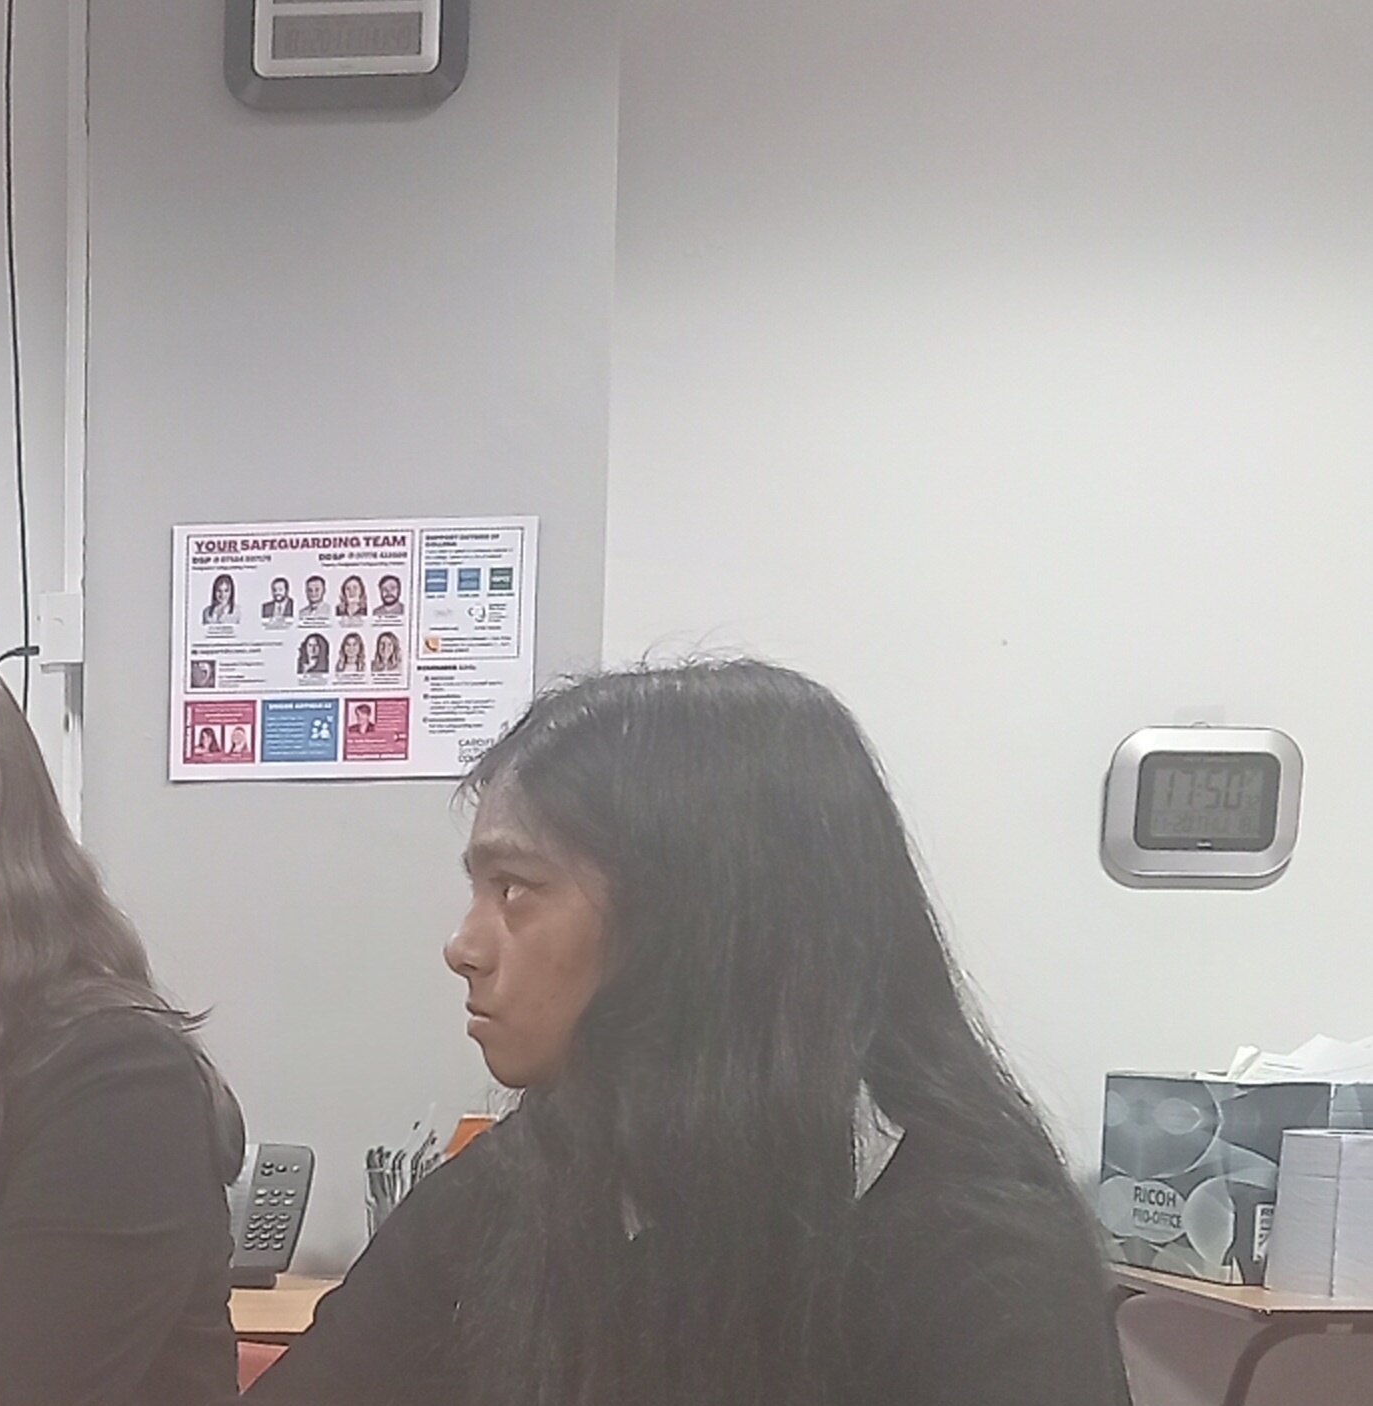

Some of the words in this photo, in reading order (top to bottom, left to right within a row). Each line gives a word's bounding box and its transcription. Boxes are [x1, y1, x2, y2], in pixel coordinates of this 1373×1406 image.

[194, 539, 239, 553] YOUR
[240, 537, 362, 551] SAFEGUARDING
[363, 536, 407, 548] TEAM
[1133, 1185, 1177, 1208] RICOH
